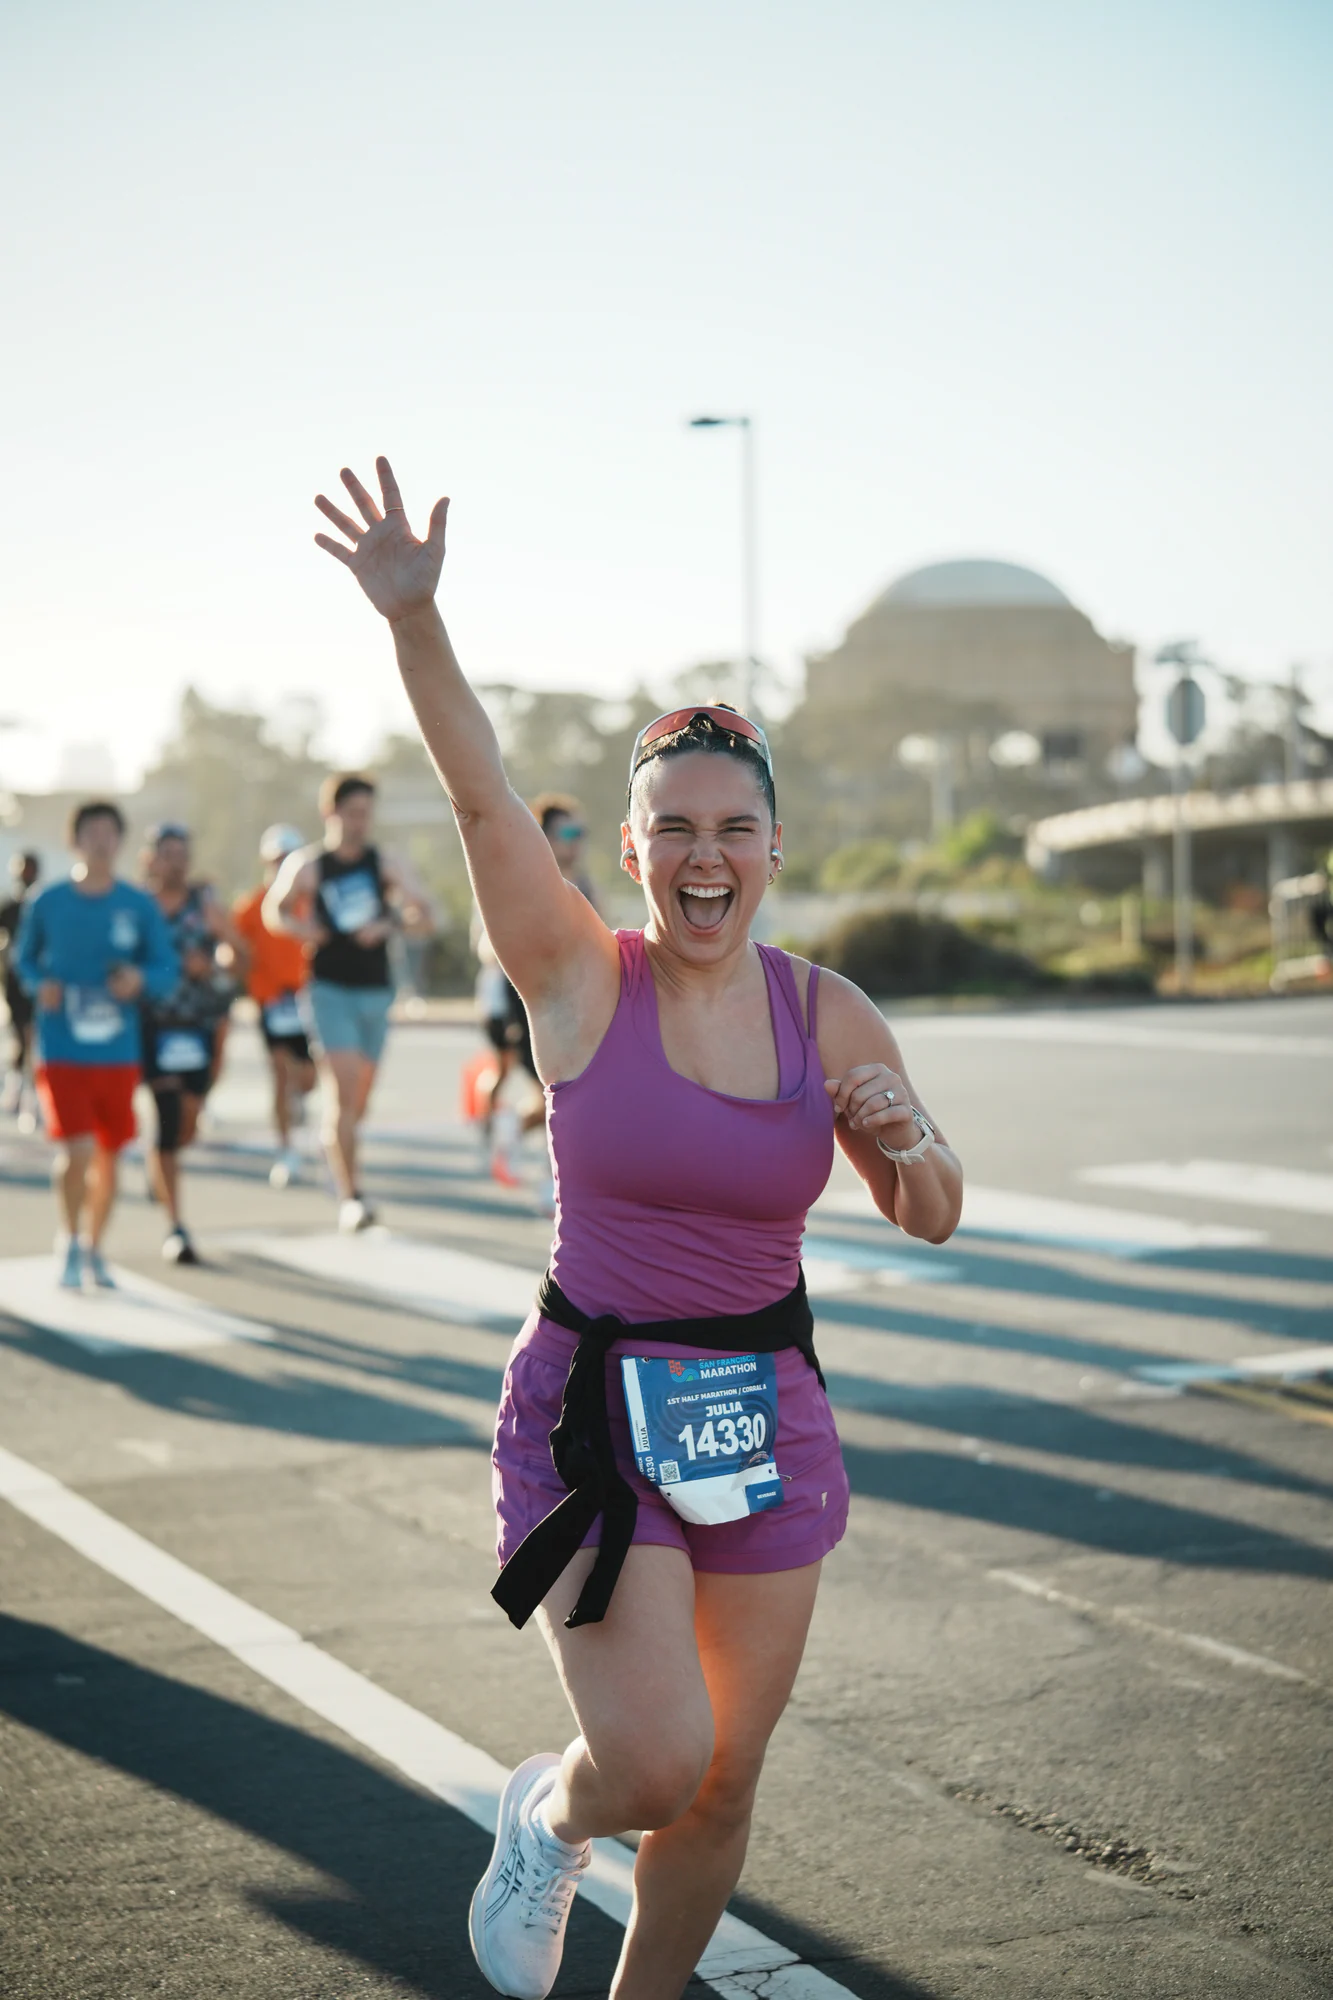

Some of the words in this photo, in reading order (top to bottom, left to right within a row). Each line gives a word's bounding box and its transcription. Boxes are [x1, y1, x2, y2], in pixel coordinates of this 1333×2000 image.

[699, 1360, 715, 1369] SAN
[717, 1354, 756, 1367] FRANCISCO
[700, 1362, 757, 1379] MARATHON
[667, 1397, 681, 1405] 1ST
[681, 1394, 699, 1403] HALF
[701, 1388, 737, 1400] MARATHON
[742, 1385, 763, 1393] CORRAL
[705, 1401, 743, 1417] JULIA
[640, 1426, 650, 1449] JULIA
[678, 1413, 766, 1460] 14330
[645, 1456, 657, 1482] 14330
